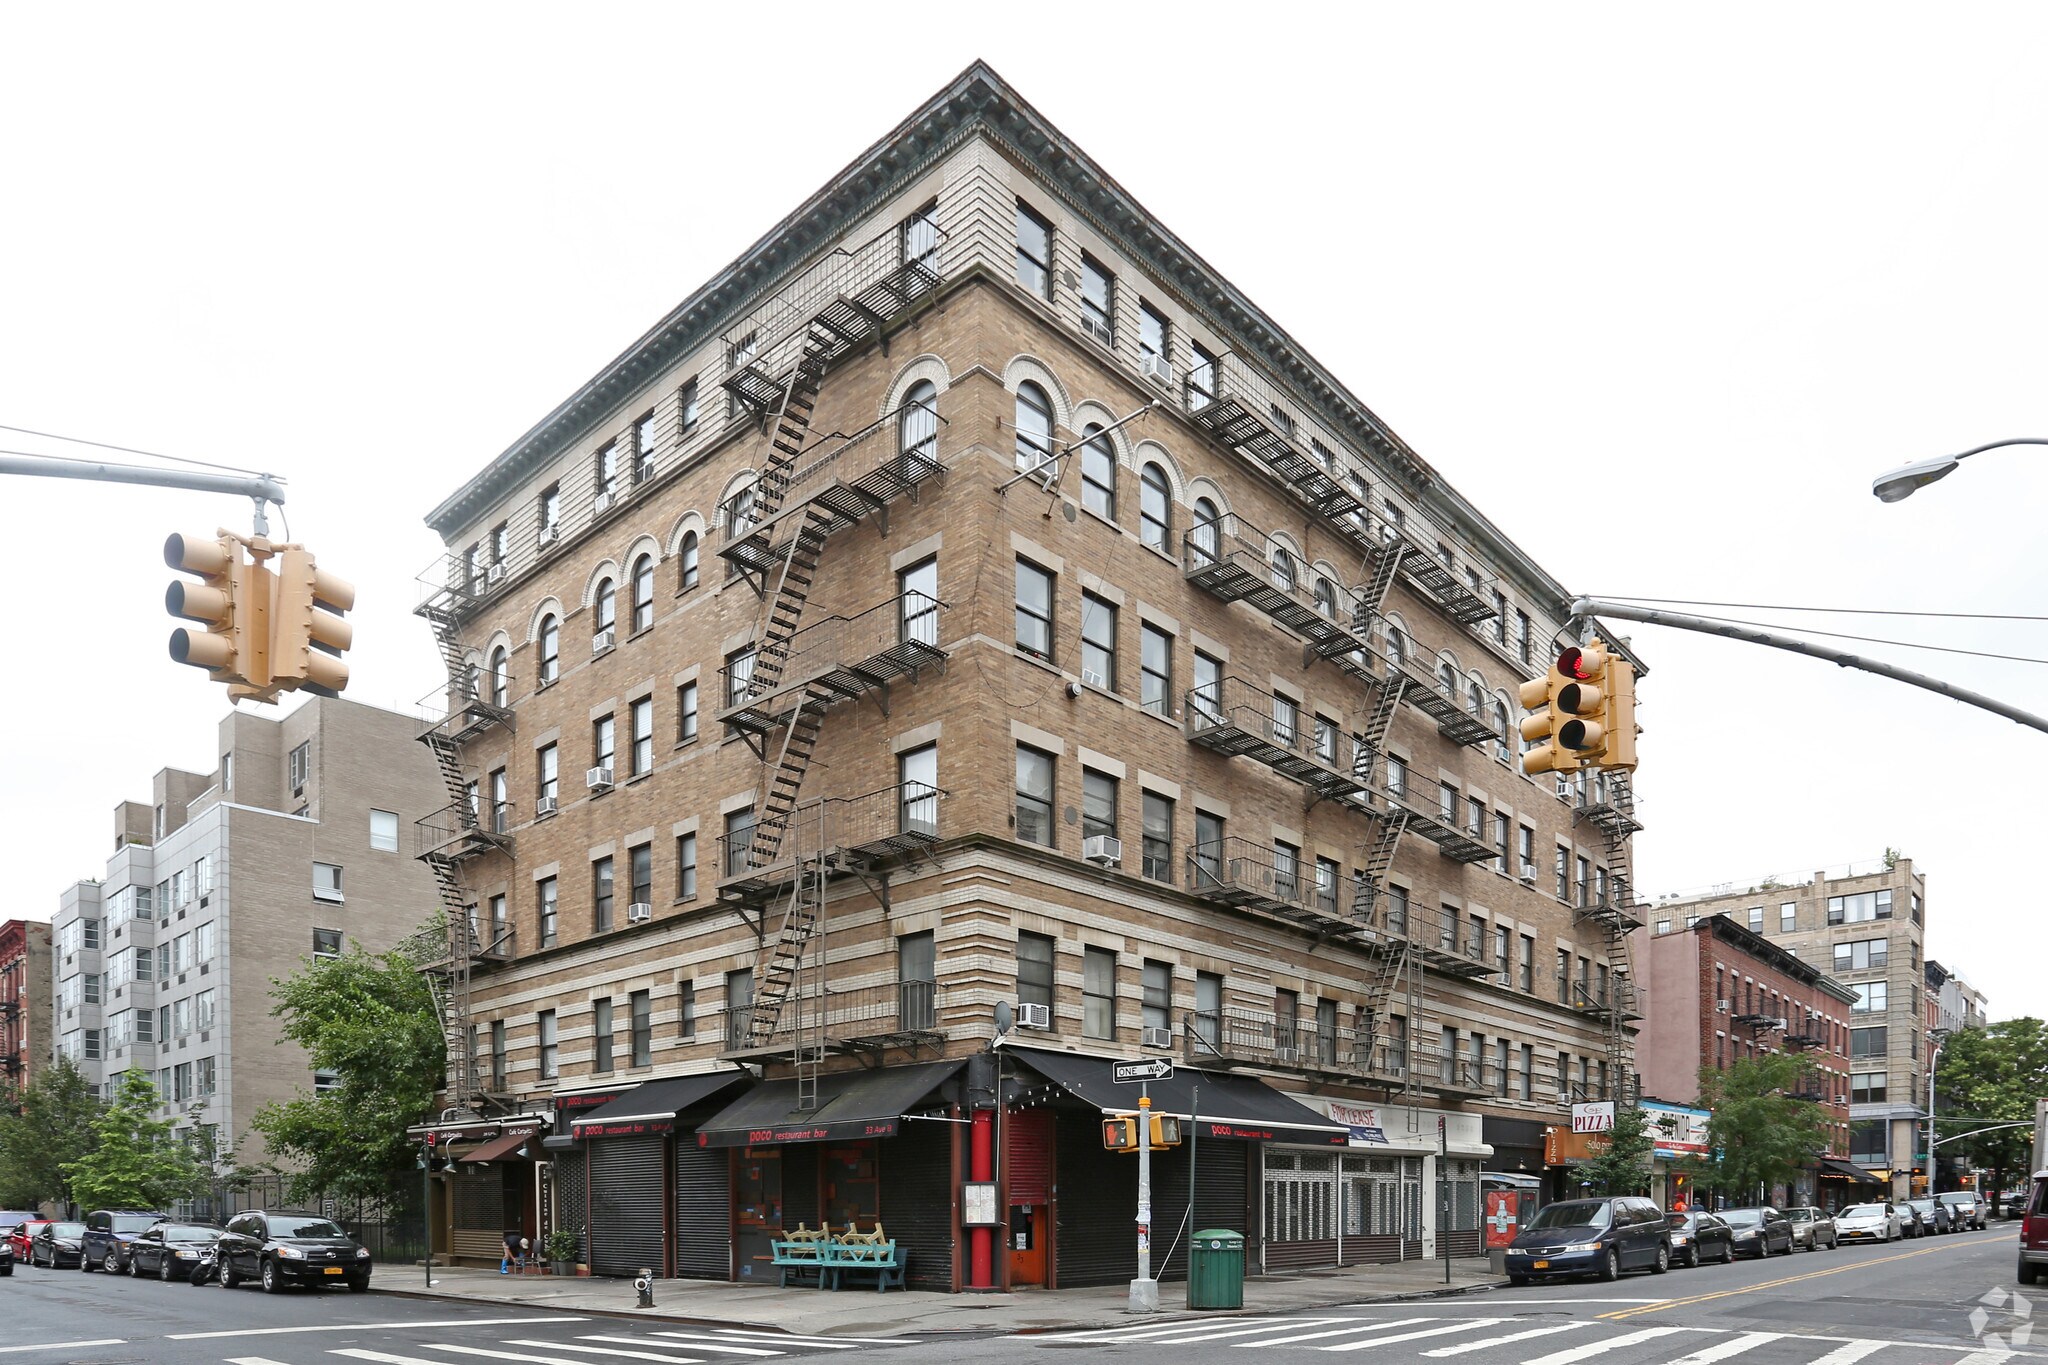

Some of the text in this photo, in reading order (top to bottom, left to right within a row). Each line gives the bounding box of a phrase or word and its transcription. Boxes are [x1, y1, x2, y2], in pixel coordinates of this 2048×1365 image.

[1118, 1064, 1166, 1077] ONE WAY
[1331, 1104, 1375, 1126] FOR LEASE
[865, 1126, 873, 1135] 33
[874, 1125, 886, 1134] Ave
[1574, 1114, 1613, 1132] PIZZA
[749, 1128, 828, 1144] poco restaurant bar
[1211, 1125, 1231, 1137] poco
